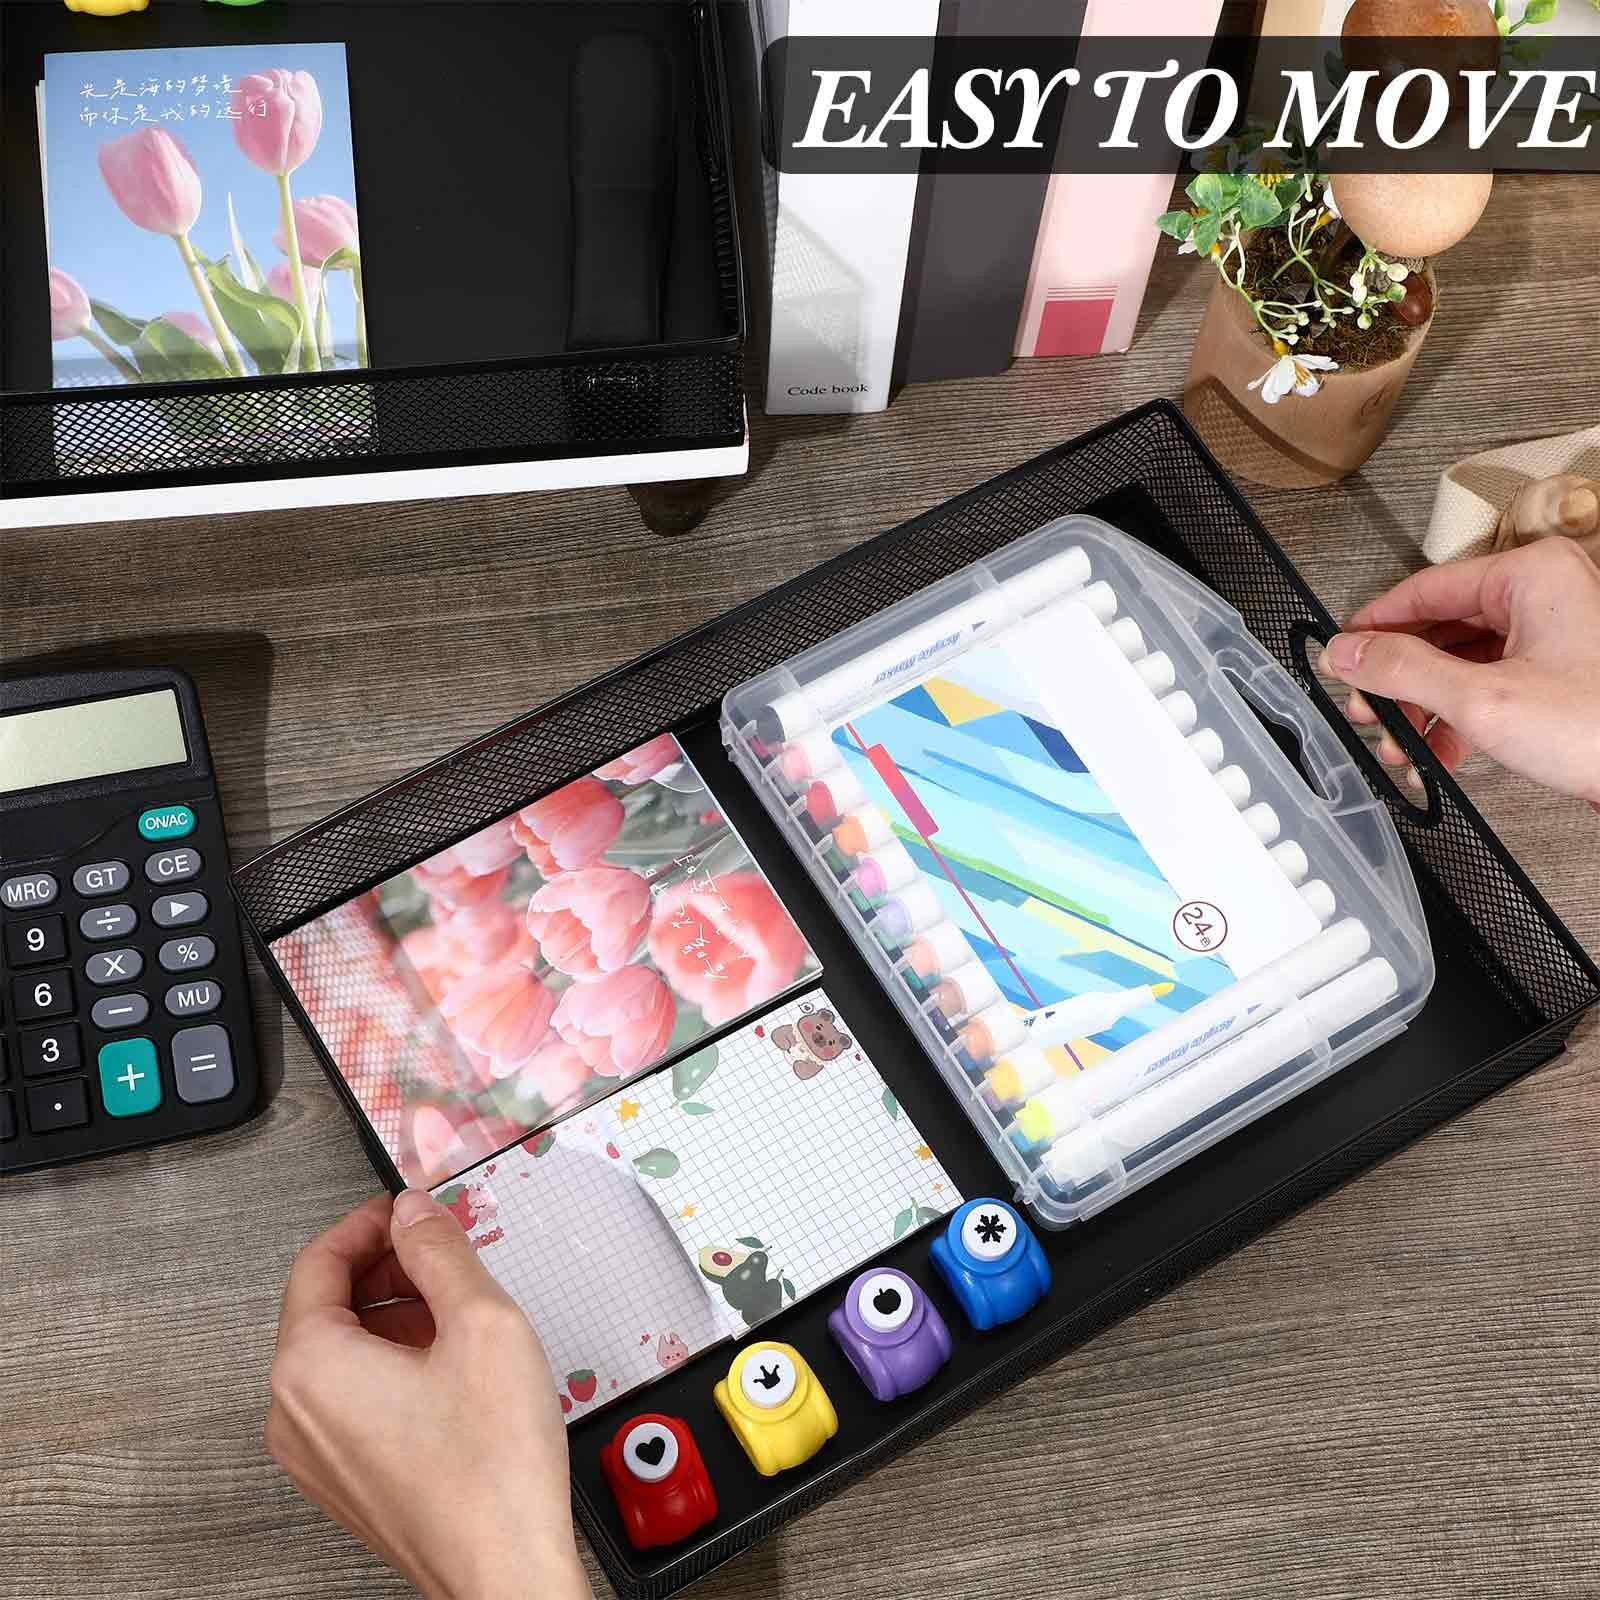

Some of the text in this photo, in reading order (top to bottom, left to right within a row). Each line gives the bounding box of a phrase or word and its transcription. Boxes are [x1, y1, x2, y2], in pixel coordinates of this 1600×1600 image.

[787, 384, 869, 396] Code book
[145, 812, 188, 831] ON/AC
[158, 854, 190, 876] CE
[86, 867, 117, 889] GT
[7, 879, 50, 902] MRC
[26, 928, 46, 951] 9
[177, 942, 199, 964] %
[34, 983, 53, 1007] 6
[177, 987, 210, 1009] MU
[41, 1038, 60, 1062] 3
